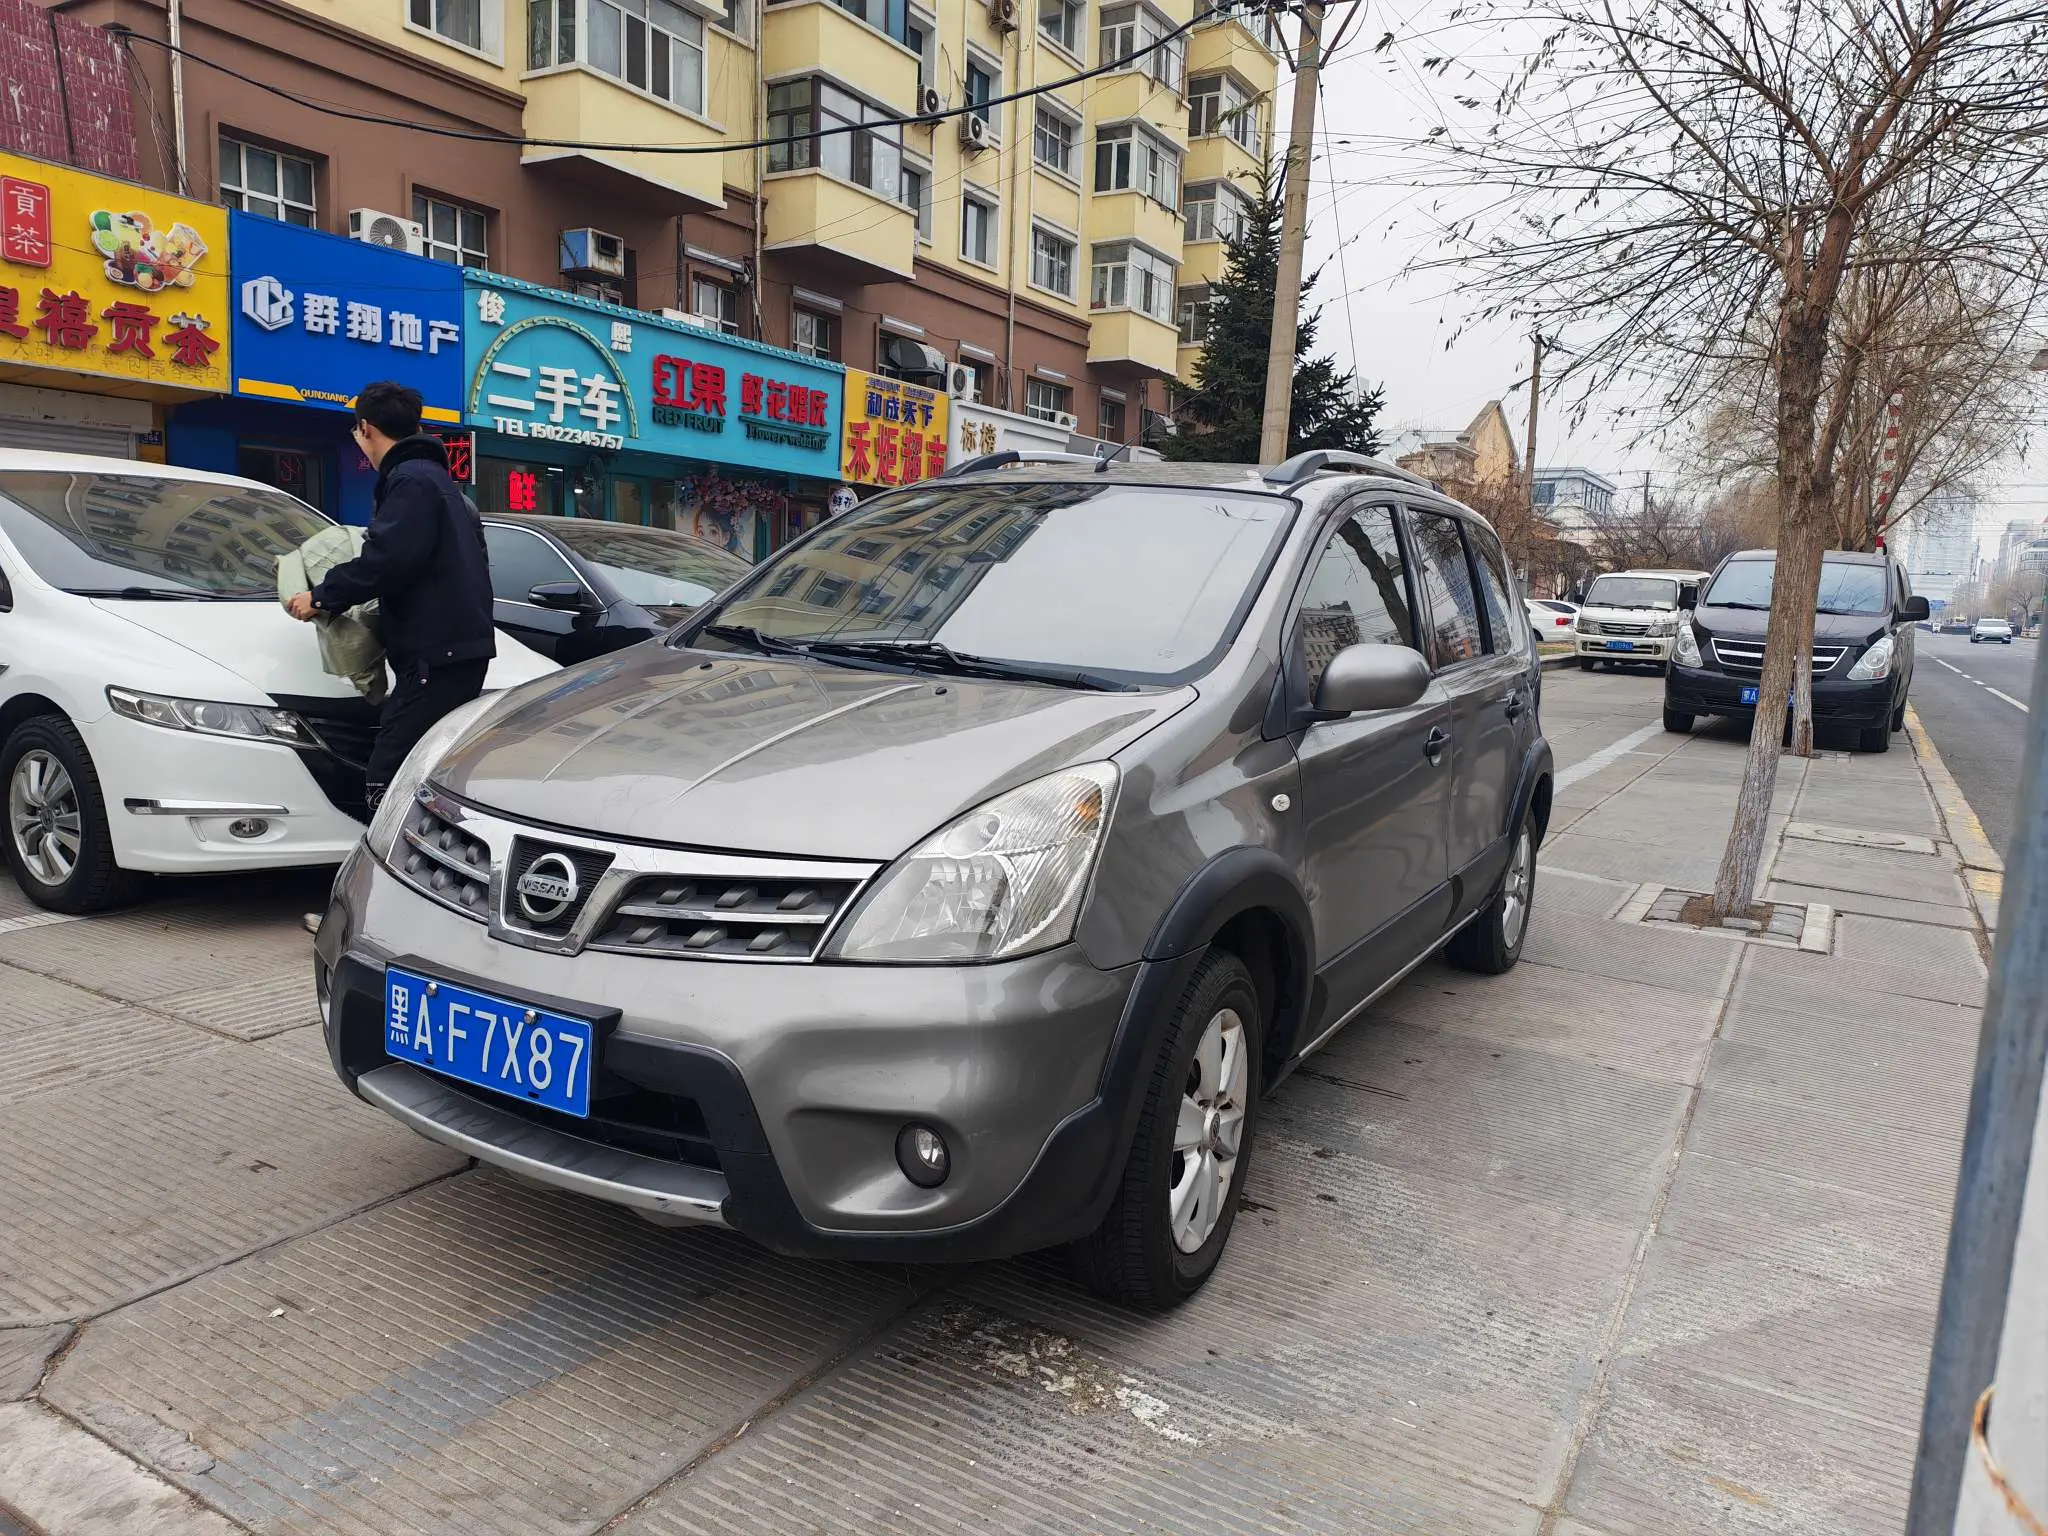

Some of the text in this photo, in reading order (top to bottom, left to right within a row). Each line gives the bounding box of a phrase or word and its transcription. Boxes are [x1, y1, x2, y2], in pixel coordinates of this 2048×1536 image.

[8, 185, 44, 254] 貢茶
[303, 292, 459, 354] 群翔地产
[477, 290, 505, 325] 俊
[300, 388, 349, 403] QUNXIANG
[488, 362, 621, 430] 二手车
[653, 354, 828, 427] 红果 鲜花婚庆
[494, 417, 623, 450] TEL 15022345757
[653, 407, 725, 433] RED FRUIT
[523, 879, 569, 897] NISSAN
